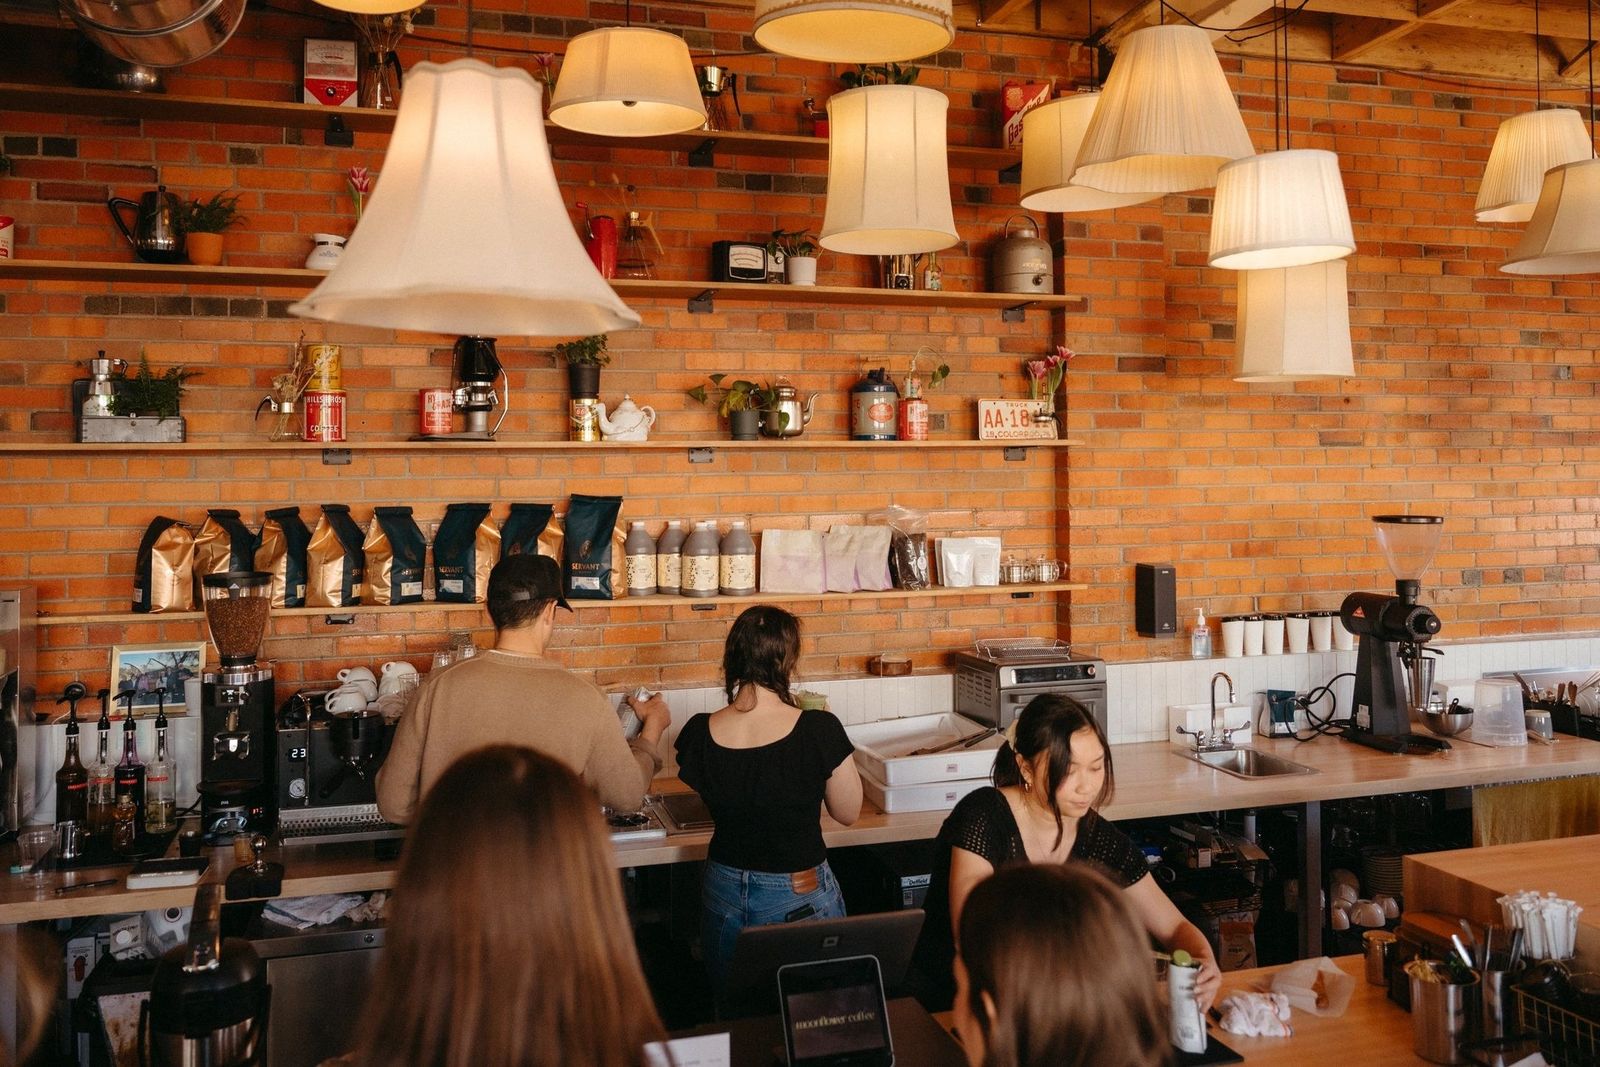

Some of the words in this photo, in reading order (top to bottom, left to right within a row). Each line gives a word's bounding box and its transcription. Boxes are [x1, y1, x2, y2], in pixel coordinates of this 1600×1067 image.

[310, 424, 339, 433] COFFEE
[571, 562, 600, 570] SERVANT
[291, 748, 306, 758] 23
[795, 1015, 846, 1030] moonflower
[847, 1011, 876, 1023] coffee
